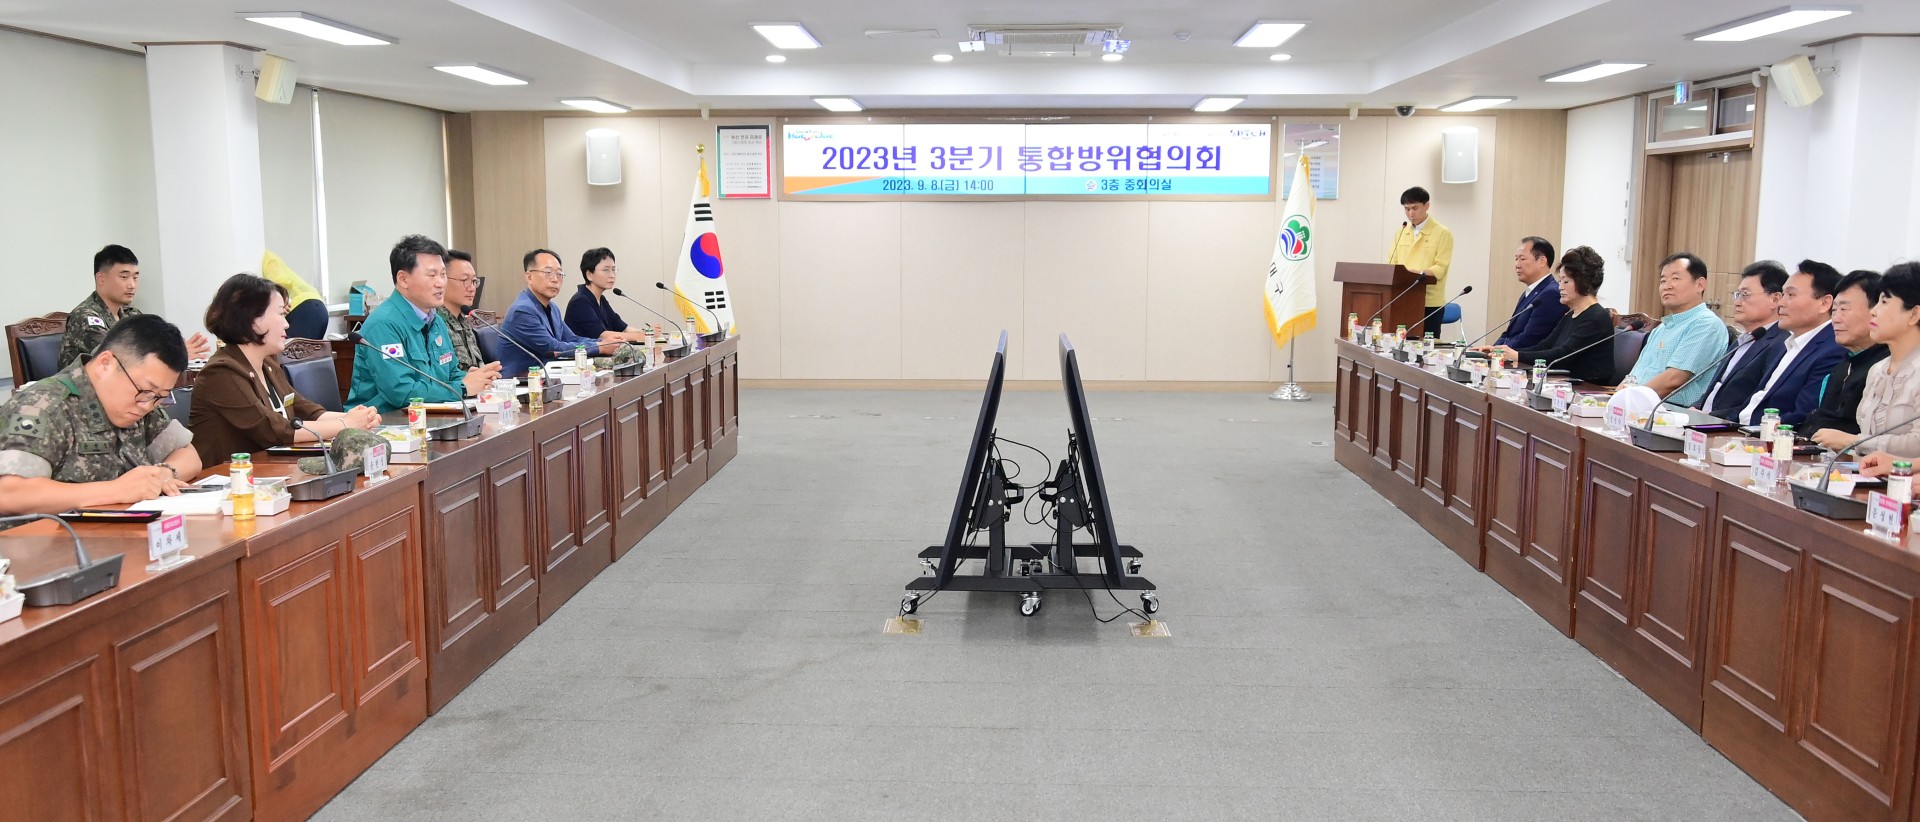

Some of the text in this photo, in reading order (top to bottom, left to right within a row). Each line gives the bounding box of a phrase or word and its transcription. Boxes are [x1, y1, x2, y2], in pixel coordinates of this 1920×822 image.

[823, 145, 1221, 172] 2023년 3분기 통합방위협의회
[883, 179, 913, 191] 2023.
[918, 180, 926, 191] 9.
[965, 180, 994, 191] 14:00
[1101, 179, 1172, 191] 3층 중회의실
